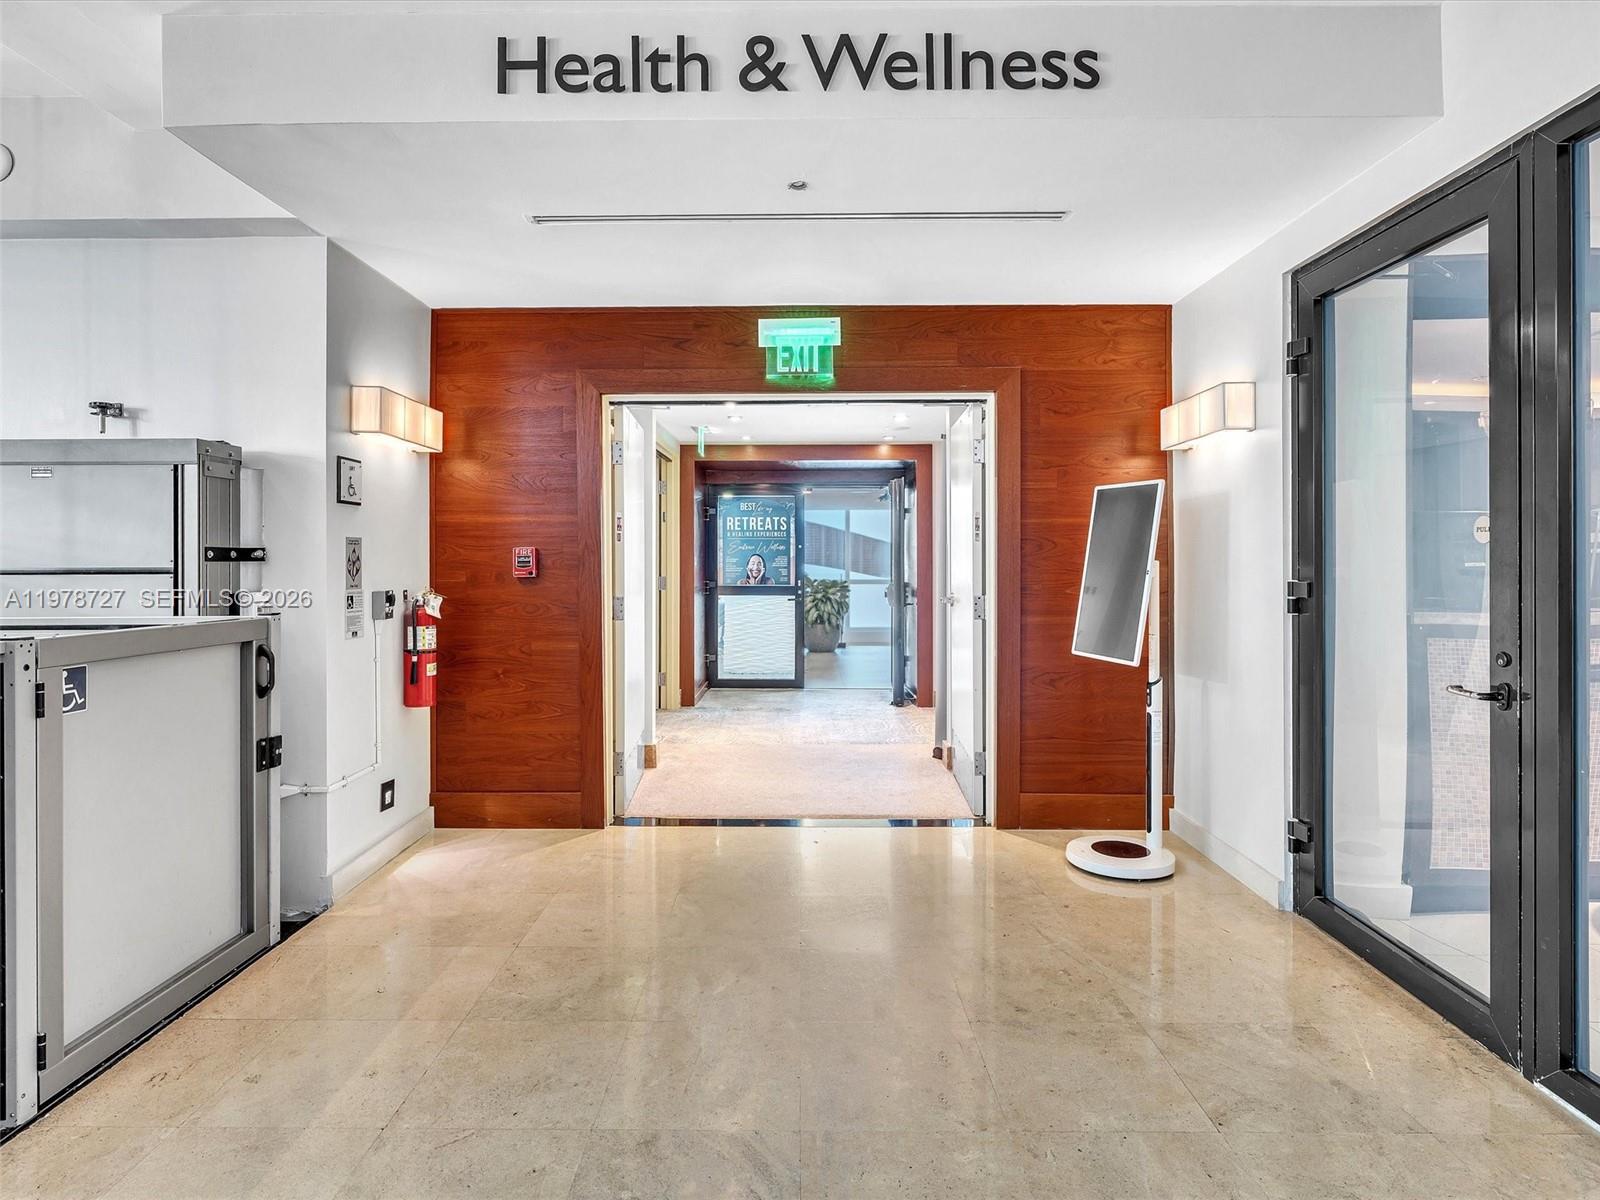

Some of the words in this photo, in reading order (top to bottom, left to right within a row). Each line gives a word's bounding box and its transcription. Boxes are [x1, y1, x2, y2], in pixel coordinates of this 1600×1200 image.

[497, 34, 710, 94] Health
[738, 35, 788, 92] &
[801, 32, 1101, 91] Wellness
[776, 343, 819, 373] EXIT
[740, 502, 756, 511] BEST
[727, 517, 787, 530] RETREATS
